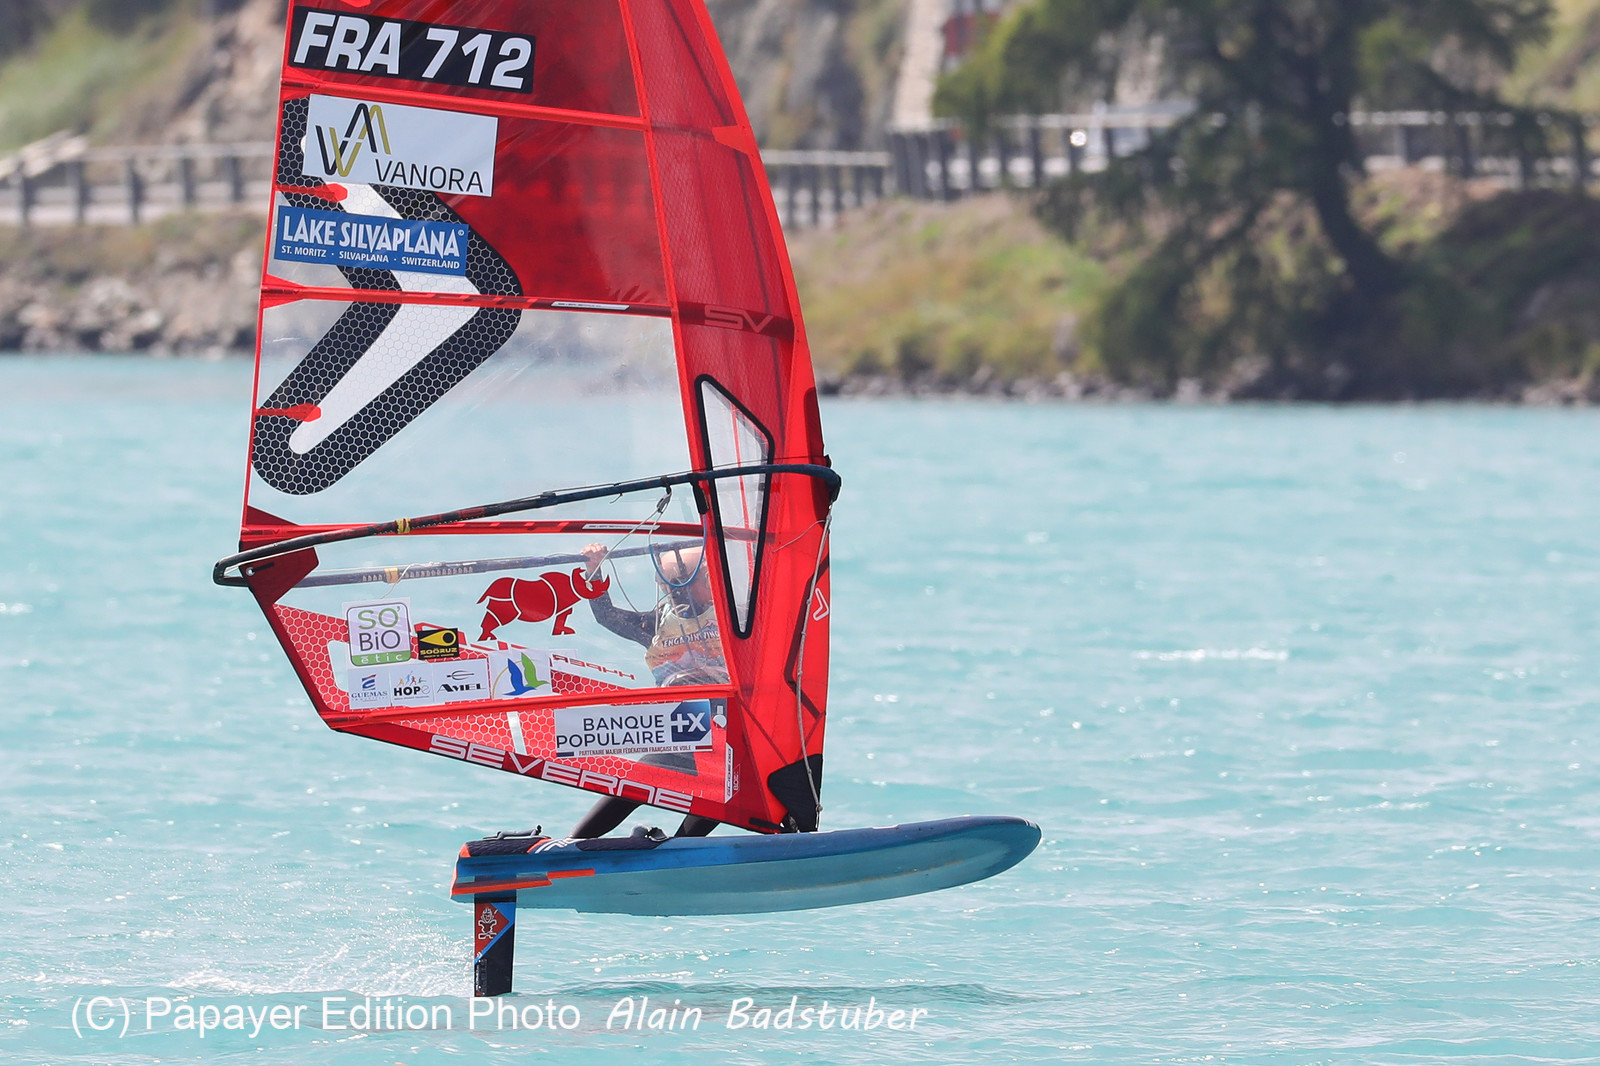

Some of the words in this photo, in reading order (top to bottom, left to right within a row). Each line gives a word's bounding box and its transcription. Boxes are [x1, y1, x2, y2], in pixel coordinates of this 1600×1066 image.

[294, 11, 402, 75] FRA
[421, 27, 532, 89] 712
[375, 158, 484, 193] VANORA
[282, 213, 337, 246] LAKE
[281, 245, 293, 255] ST.
[294, 246, 327, 258] MORITZ
[339, 250, 389, 263] SILVAPLANA
[401, 256, 460, 269] SWITZERLAND
[351, 690, 388, 699] GUEMAS
[583, 714, 664, 731] BANQUE
[556, 730, 665, 749] POPULAIRE
[429, 734, 694, 813] SEVERNE
